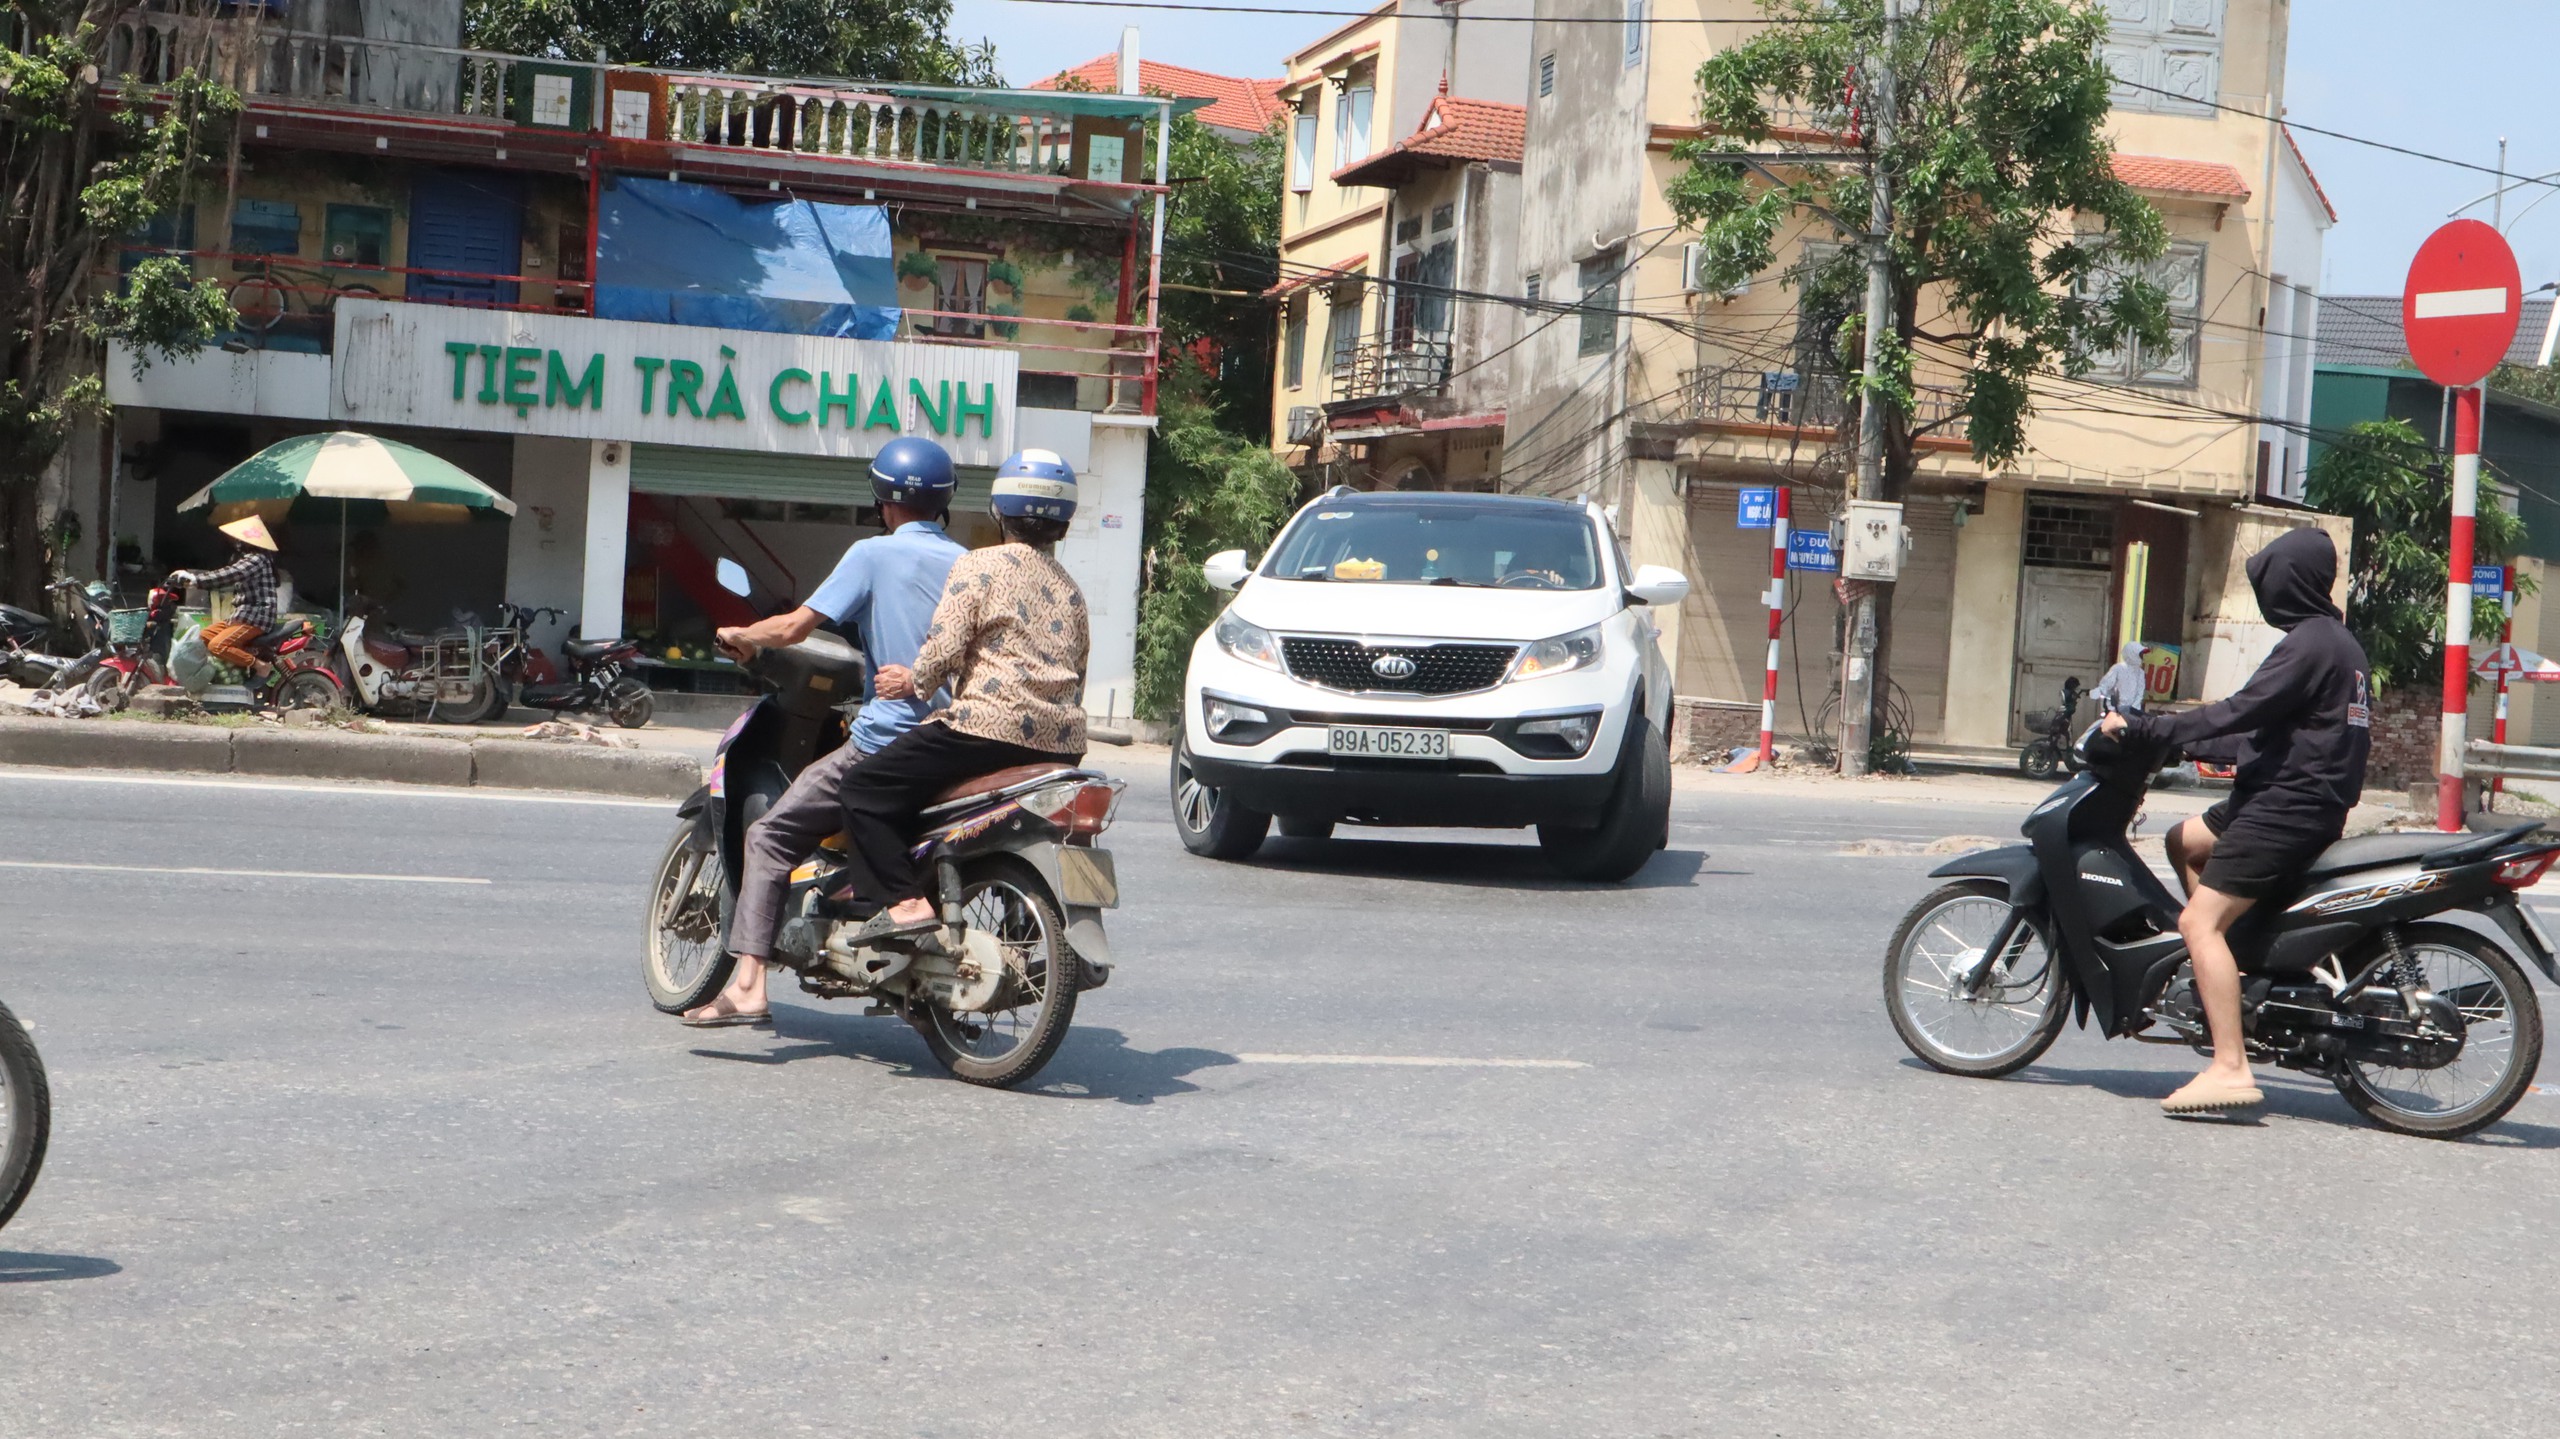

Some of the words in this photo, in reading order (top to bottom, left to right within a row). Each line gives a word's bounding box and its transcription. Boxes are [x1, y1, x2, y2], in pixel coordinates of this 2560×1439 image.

[634, 344, 747, 420] TRÀ
[769, 366, 994, 439] CHANH
[2472, 568, 2497, 579] ƯỜNG
[1379, 660, 1409, 674] KIA
[2144, 656, 2176, 695] HỞ
[1333, 729, 1445, 755] 89A-052.33
[2080, 872, 2124, 887] HONDA
